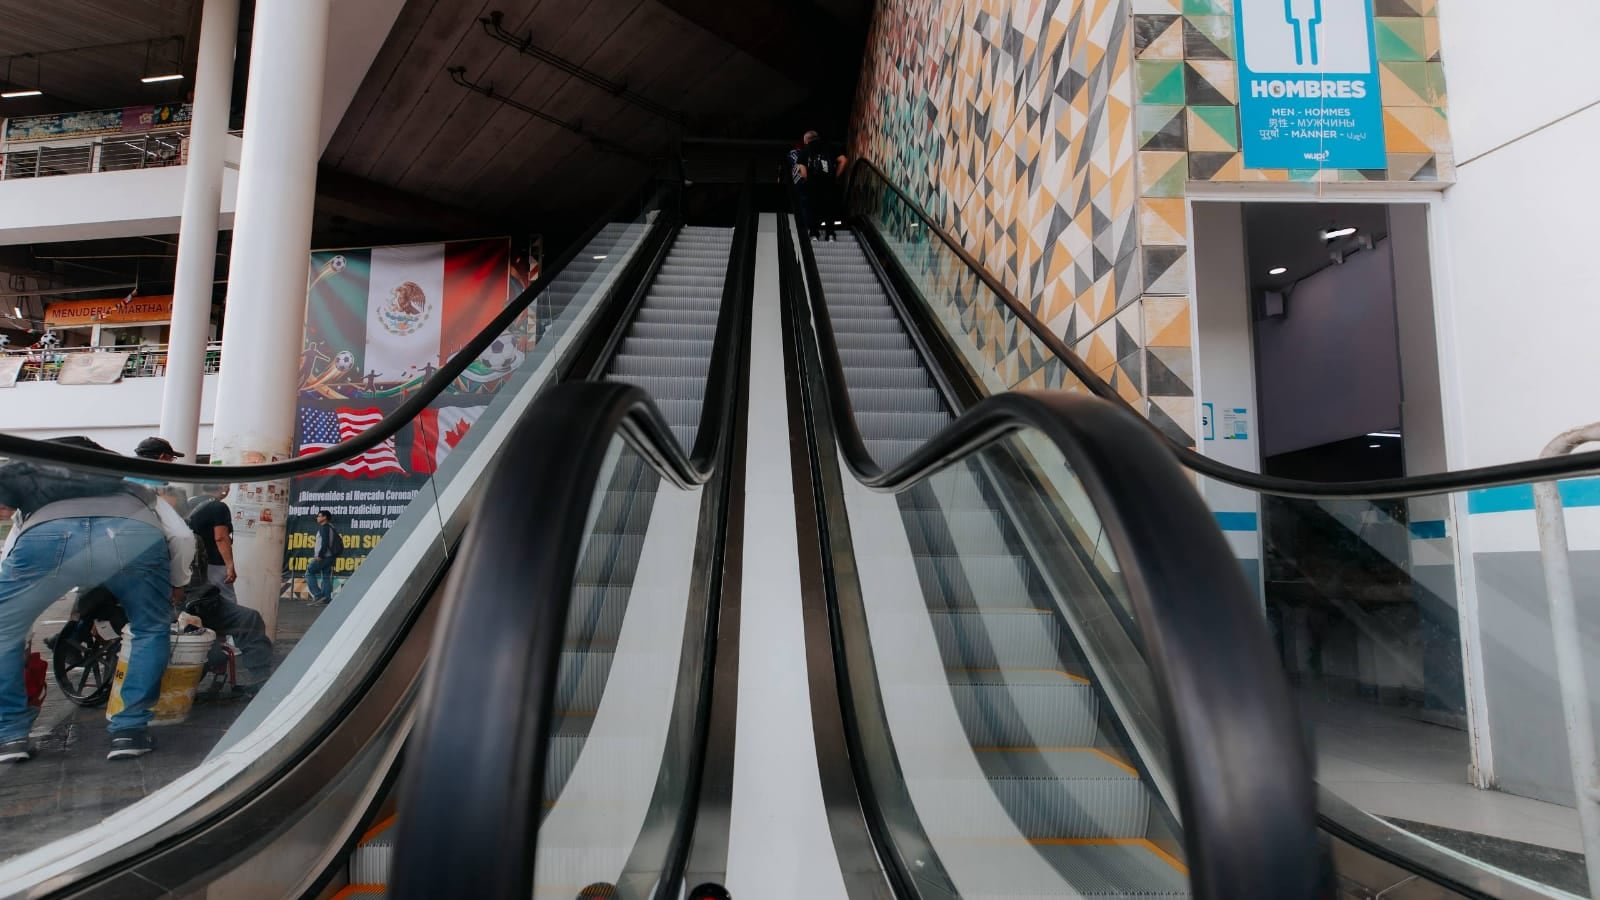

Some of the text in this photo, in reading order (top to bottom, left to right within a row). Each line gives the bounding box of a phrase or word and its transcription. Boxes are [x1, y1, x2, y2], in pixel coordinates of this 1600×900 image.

[1250, 79, 1367, 99] HOMBRES
[1271, 108, 1295, 116] MEN
[1304, 108, 1351, 117] HOMMES
[1297, 119, 1355, 128] МУЖЧИНЫ
[1291, 129, 1337, 138] MÄNNER
[117, 303, 163, 315] MARTHA
[353, 489, 384, 501] Mercado
[348, 504, 381, 515] tradición
[382, 505, 387, 516] y
[359, 519, 382, 530] mayor
